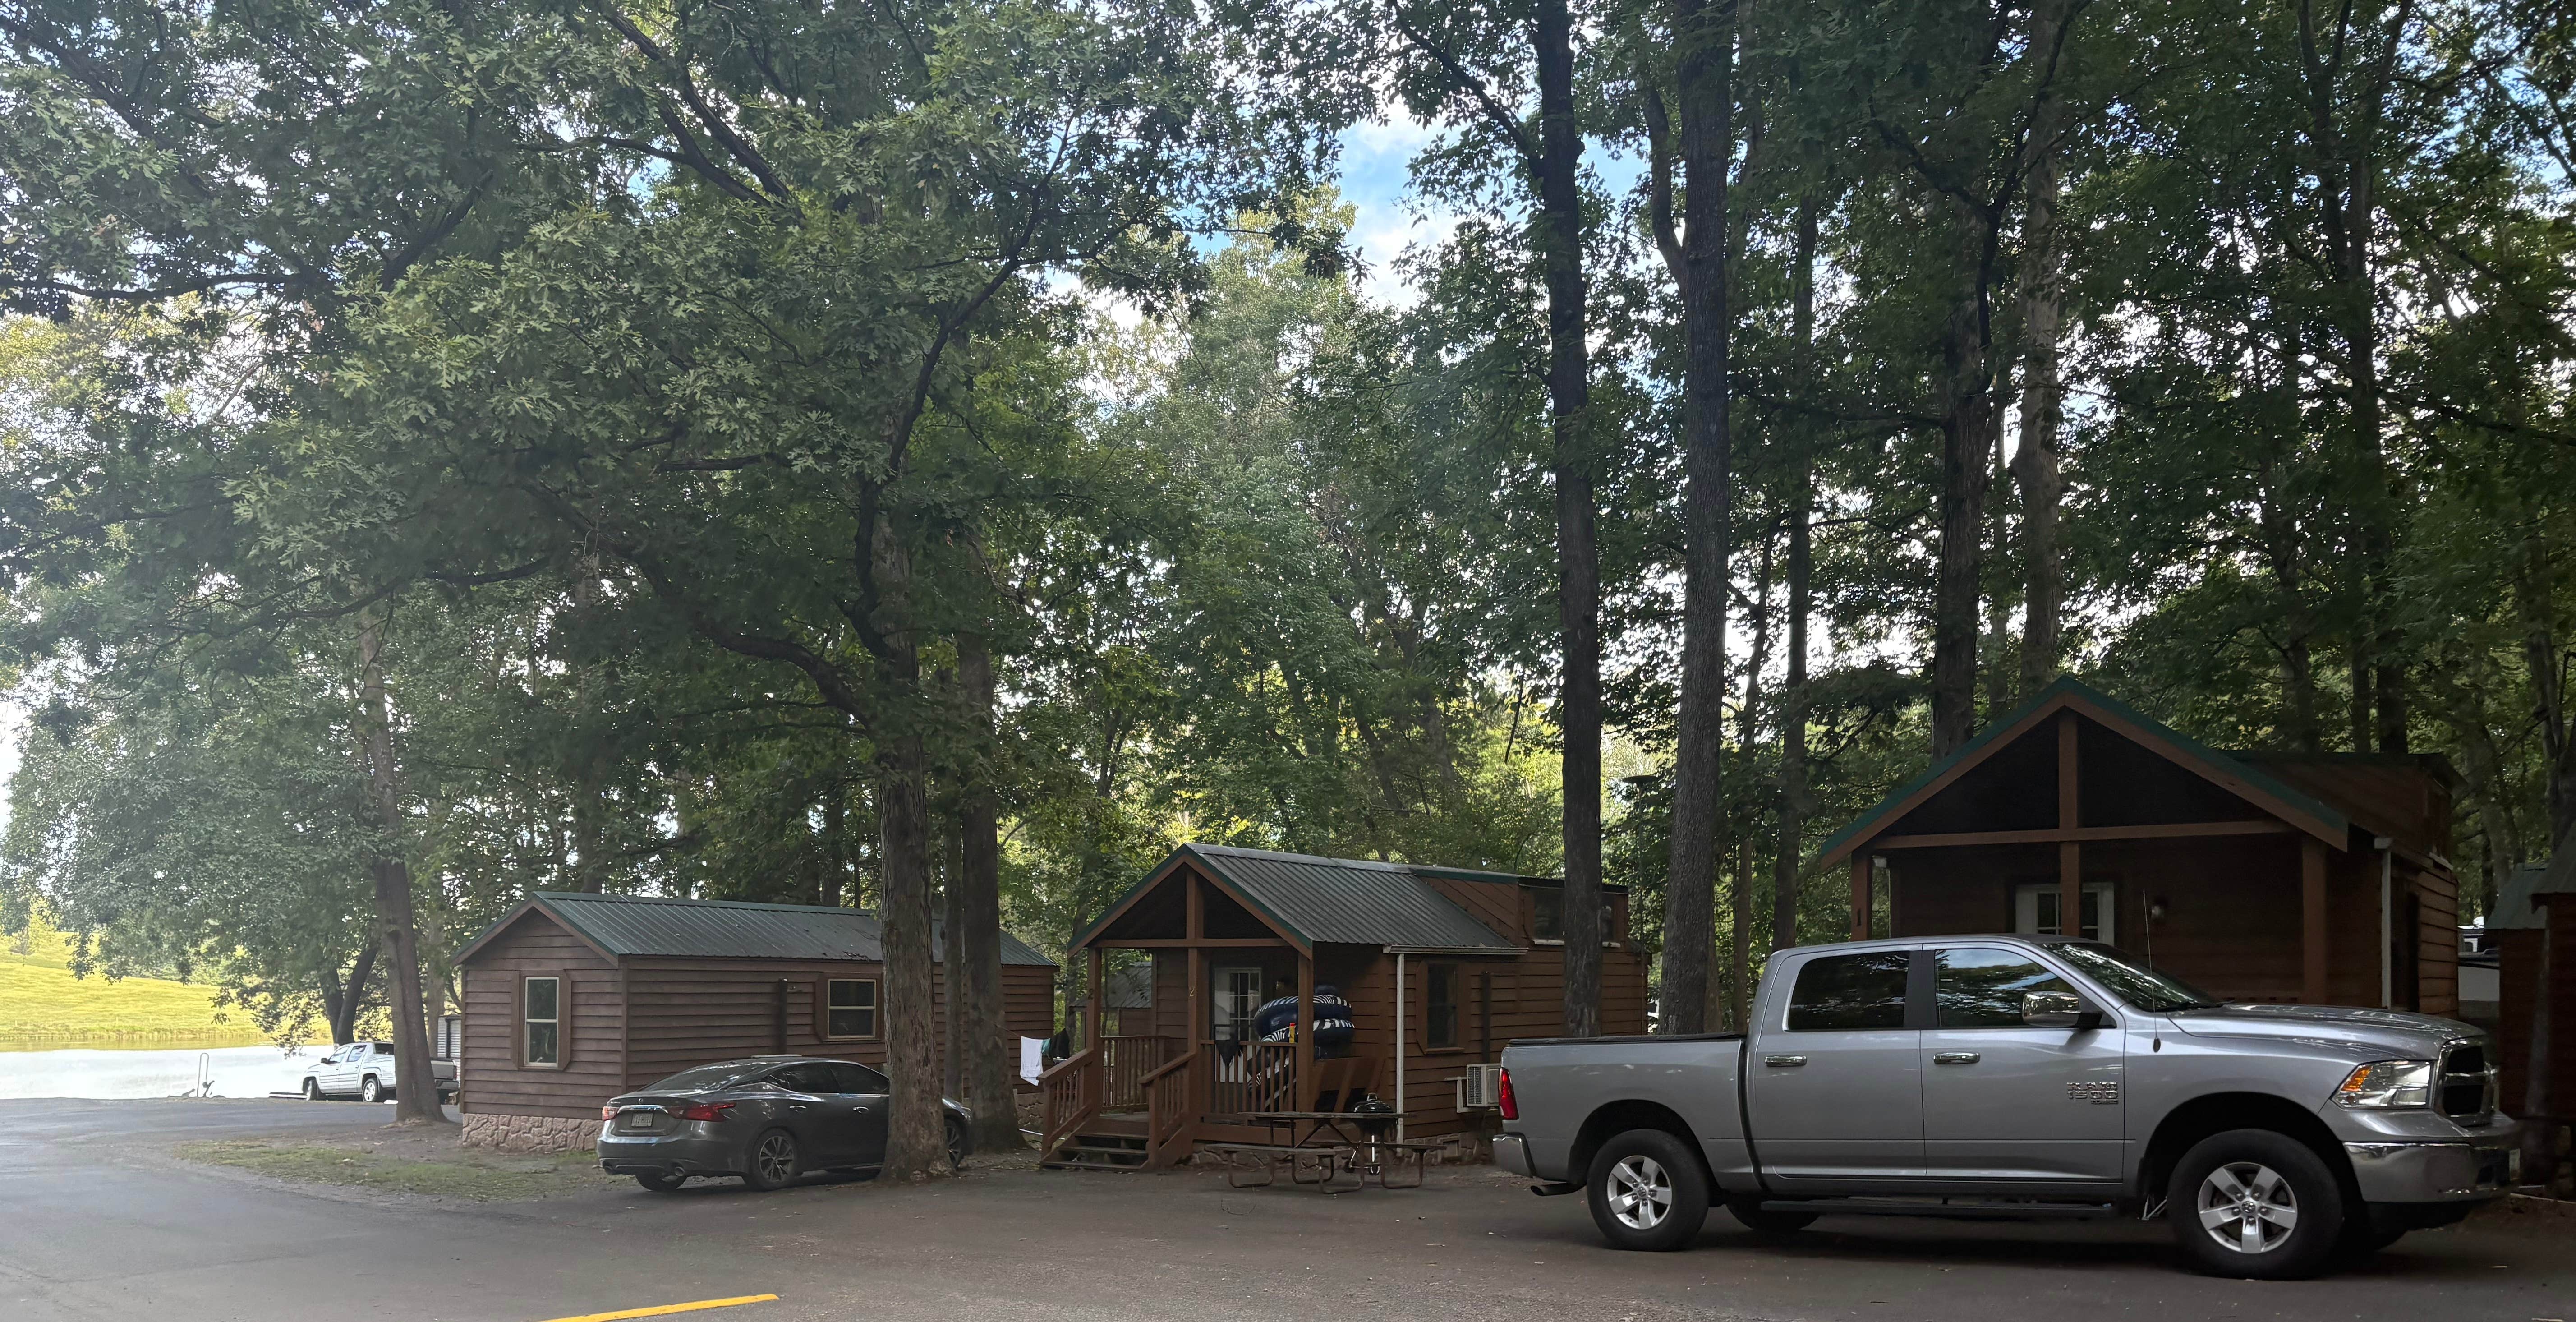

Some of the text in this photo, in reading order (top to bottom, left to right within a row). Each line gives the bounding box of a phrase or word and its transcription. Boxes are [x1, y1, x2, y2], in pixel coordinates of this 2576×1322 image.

[1088, 988, 1094, 1000] 2
[1189, 986, 1195, 997] 2
[2067, 1082, 2117, 1091] RAM
[2067, 1091, 2118, 1099] 1500
